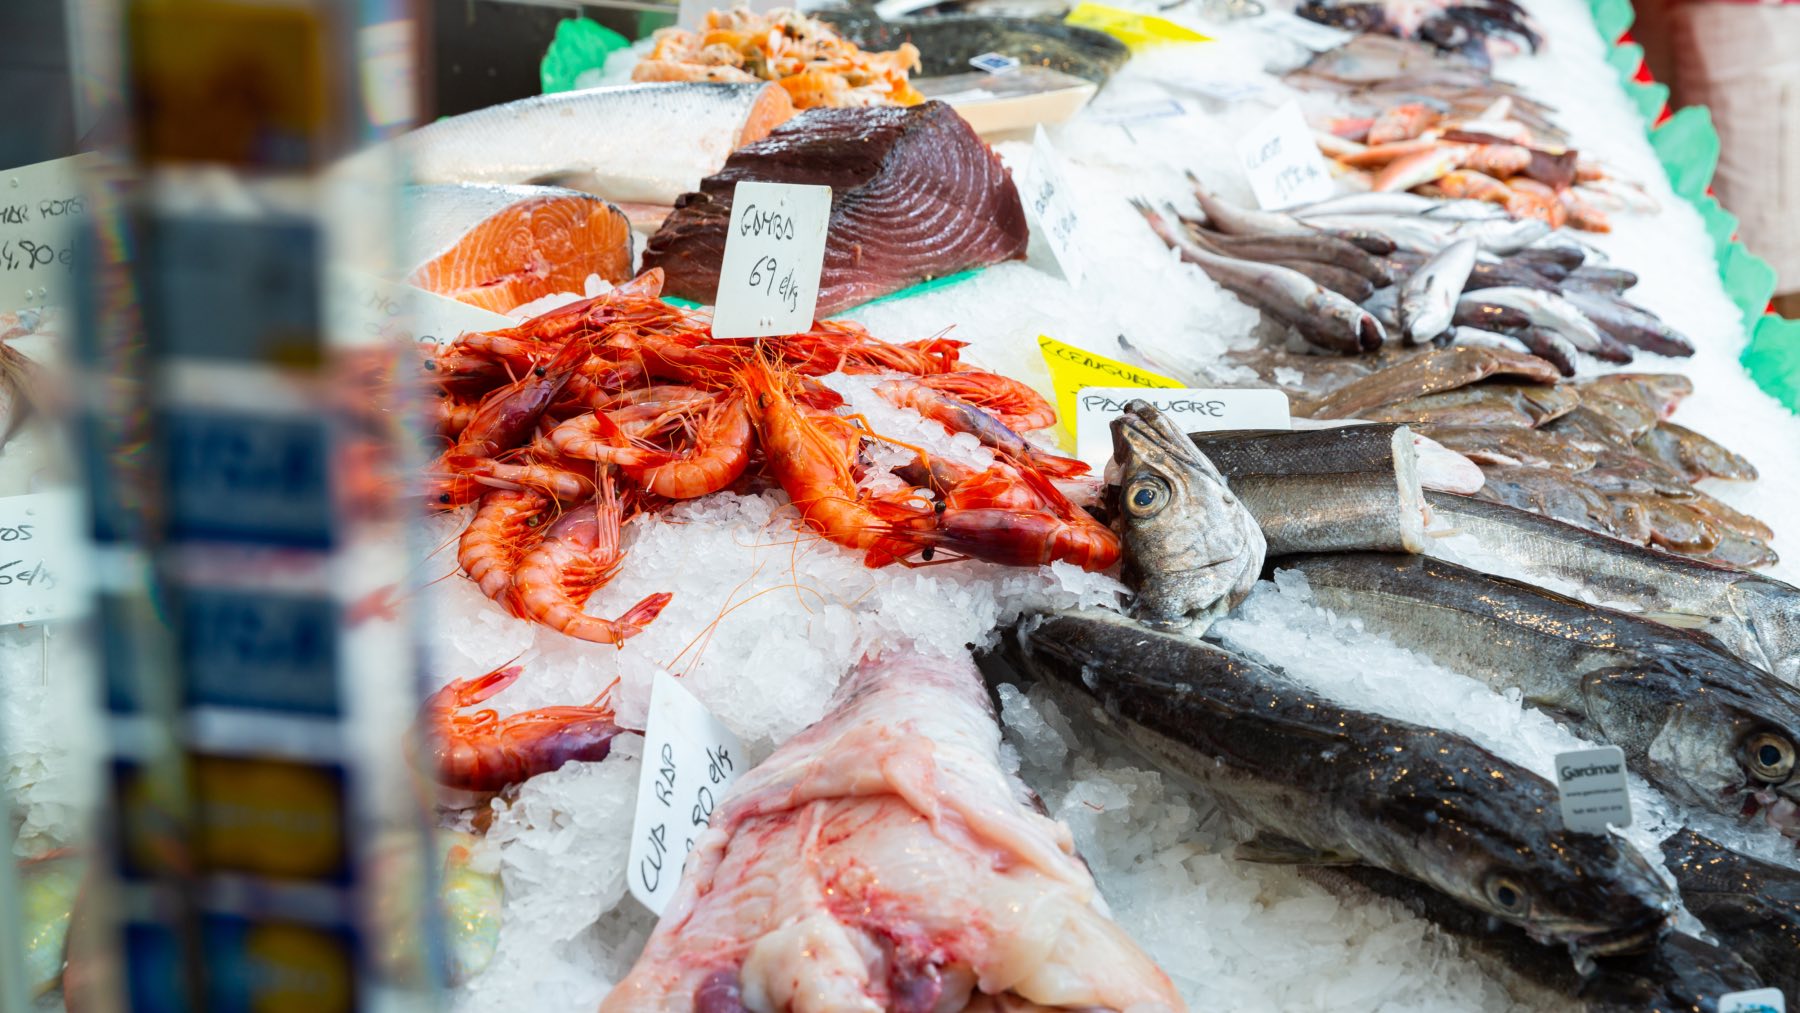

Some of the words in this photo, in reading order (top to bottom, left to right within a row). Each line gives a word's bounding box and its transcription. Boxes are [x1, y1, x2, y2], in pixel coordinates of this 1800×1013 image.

[740, 203, 795, 241] GAMBA
[0, 239, 54, 271] 4,90
[1082, 395, 1226, 418] PALNGRE
[655, 742, 677, 808] RAP
[1561, 763, 1622, 782] Garcimar
